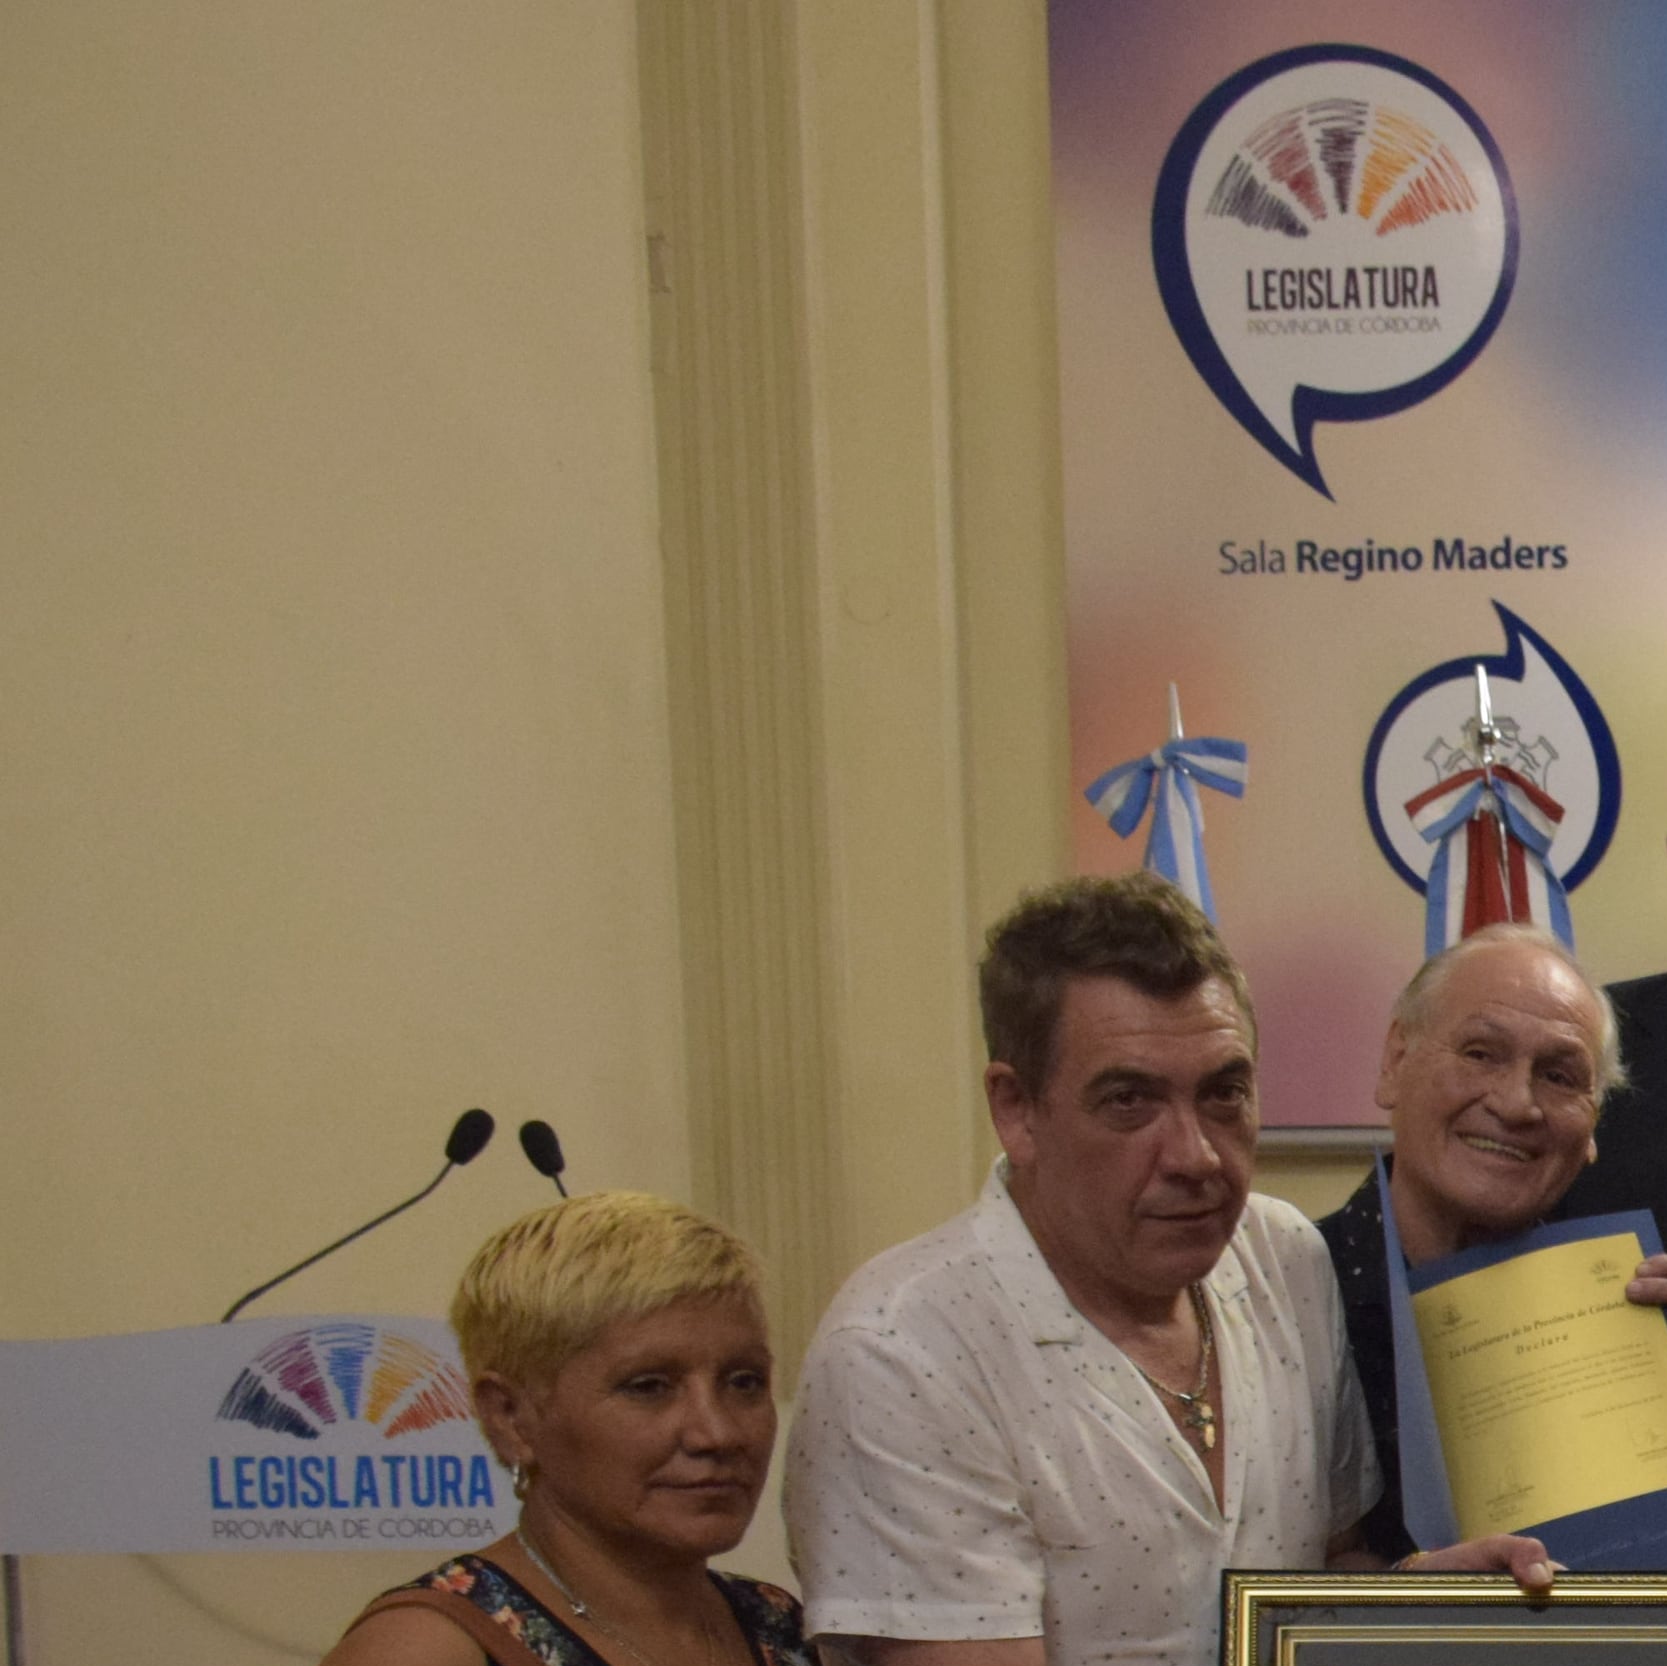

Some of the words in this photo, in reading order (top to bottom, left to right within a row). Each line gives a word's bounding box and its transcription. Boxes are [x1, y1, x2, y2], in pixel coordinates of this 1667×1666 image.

[1245, 264, 1440, 311] LEGISLATURA
[1247, 317, 1331, 336] PROVINCIA
[1334, 317, 1353, 335] DE
[1218, 540, 1286, 577] Sala
[1296, 538, 1424, 581] Regino
[1432, 534, 1569, 572] Maders
[208, 1454, 496, 1510] LEGISLATURA
[212, 1518, 337, 1540] PROVINCIA
[343, 1518, 370, 1539] DE
